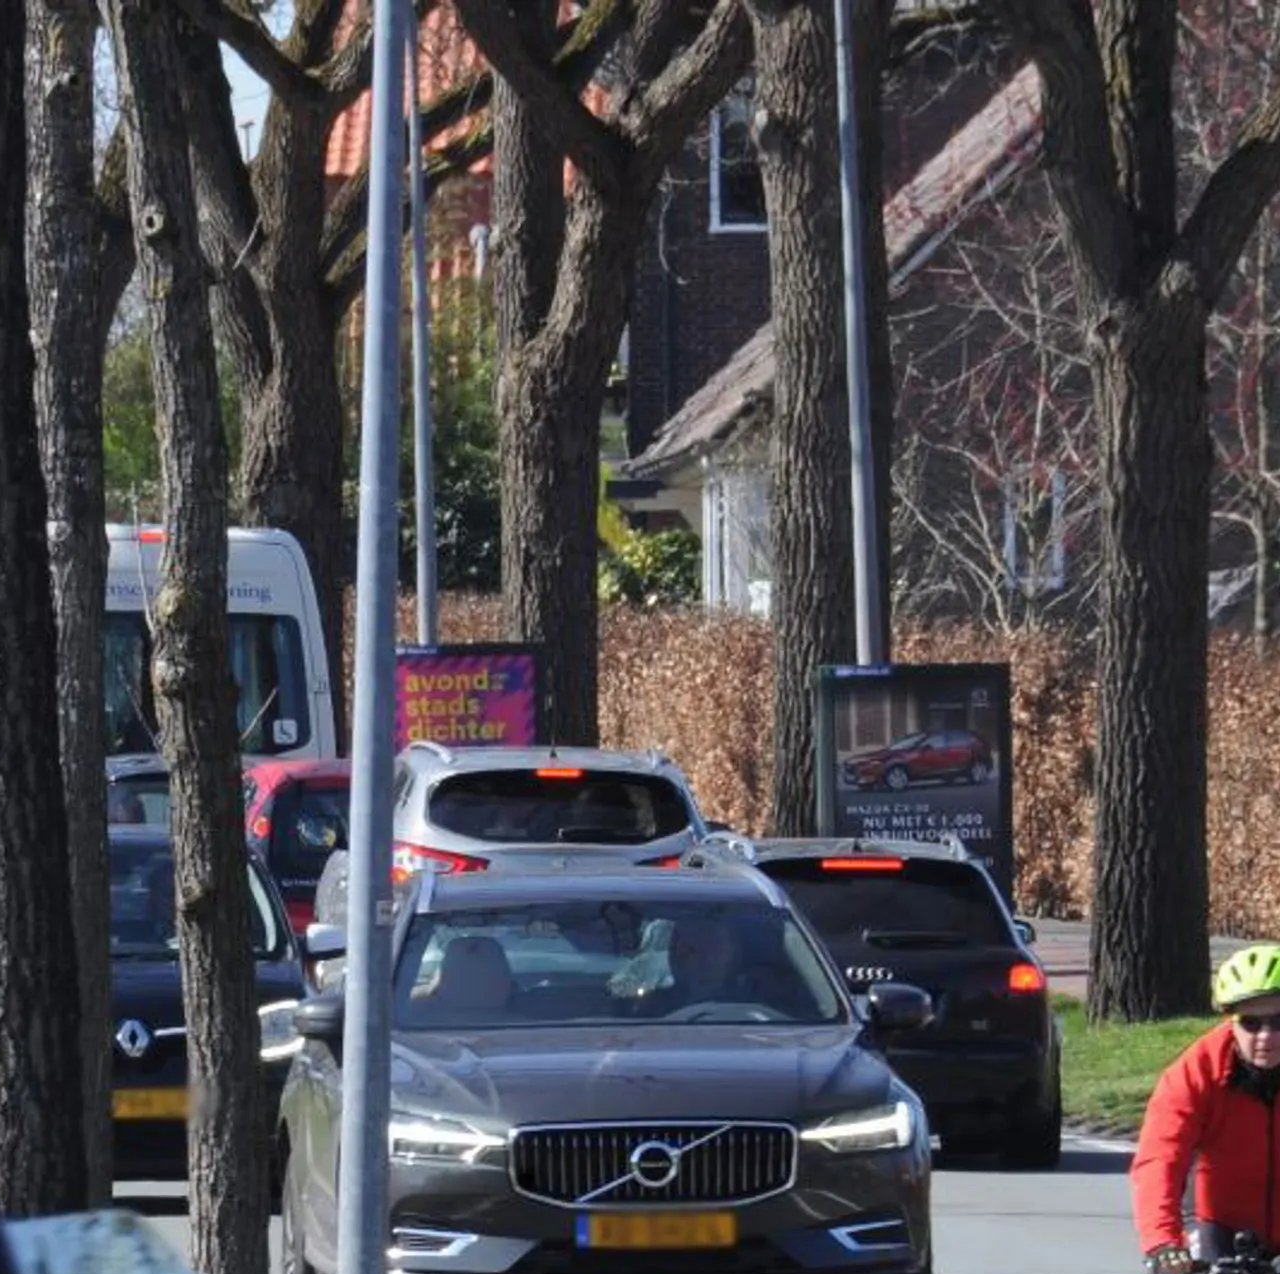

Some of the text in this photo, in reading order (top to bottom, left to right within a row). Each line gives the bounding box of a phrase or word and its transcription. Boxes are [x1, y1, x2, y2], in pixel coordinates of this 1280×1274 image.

[405, 668, 488, 693] avond
[405, 692, 480, 717] stads
[407, 717, 507, 741] dichter
[862, 816, 886, 829] NU
[892, 815, 920, 828] MET
